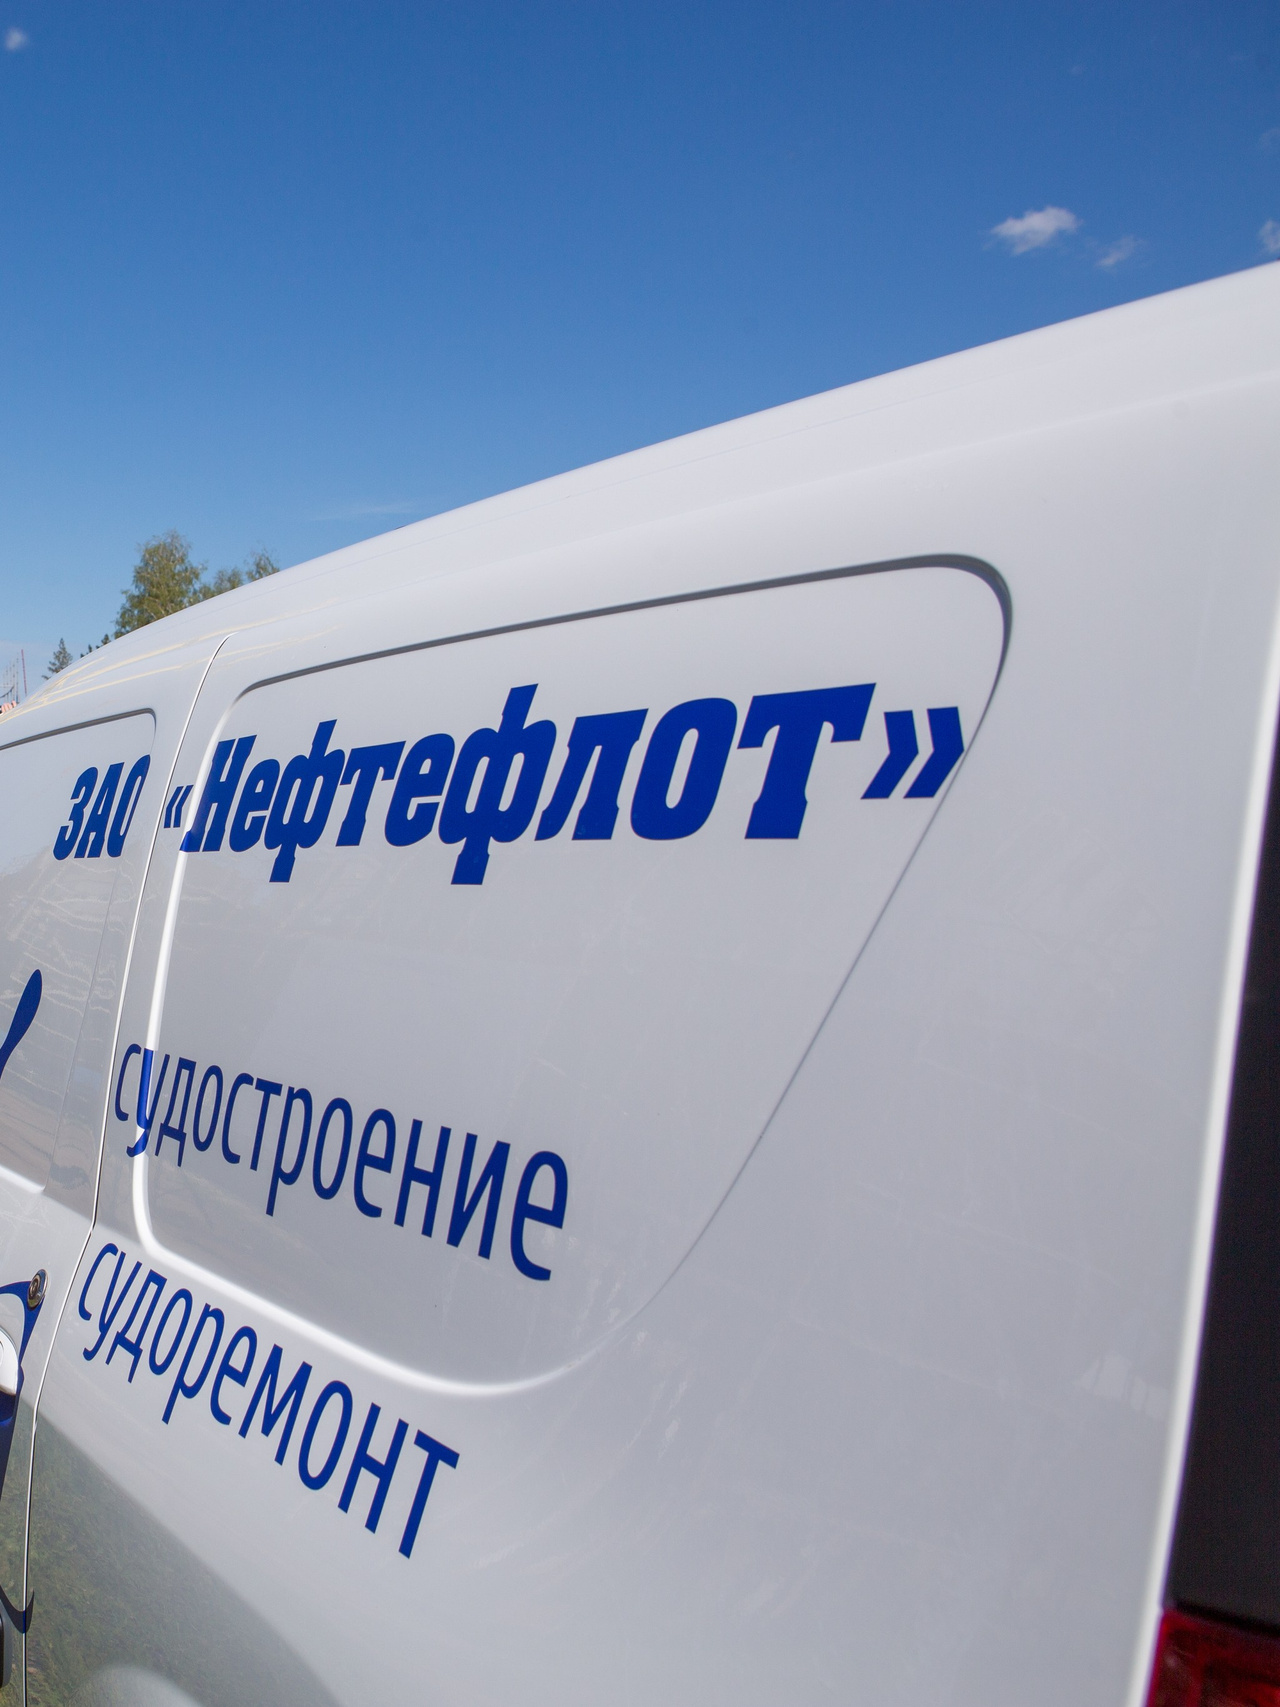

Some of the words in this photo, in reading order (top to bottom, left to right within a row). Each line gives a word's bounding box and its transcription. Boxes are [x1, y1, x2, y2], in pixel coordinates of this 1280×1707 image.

[53, 754, 151, 861] ЗАО
[163, 682, 966, 885] «Нефтефлот»
[114, 1042, 569, 1282] судостроение
[78, 1242, 461, 1560] судоремонт
